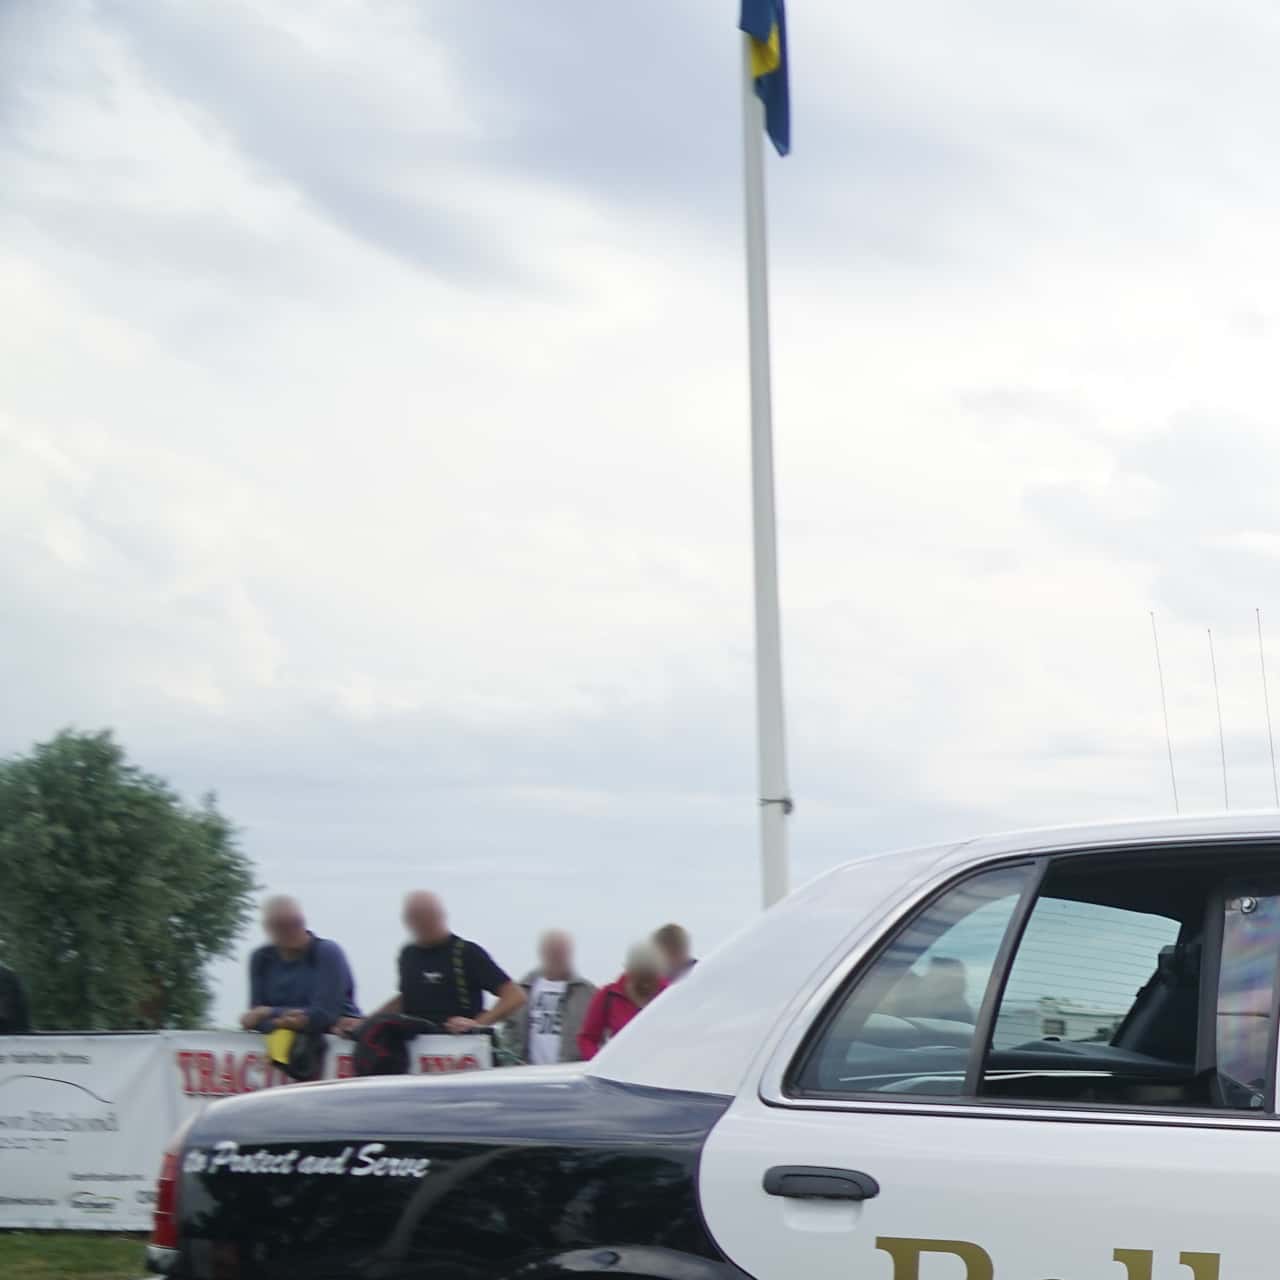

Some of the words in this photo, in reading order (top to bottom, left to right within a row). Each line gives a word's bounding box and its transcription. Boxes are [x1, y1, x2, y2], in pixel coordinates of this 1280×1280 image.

[208, 1141, 299, 1174] Protect
[297, 1147, 353, 1175] and
[351, 1143, 431, 1178] Serve
